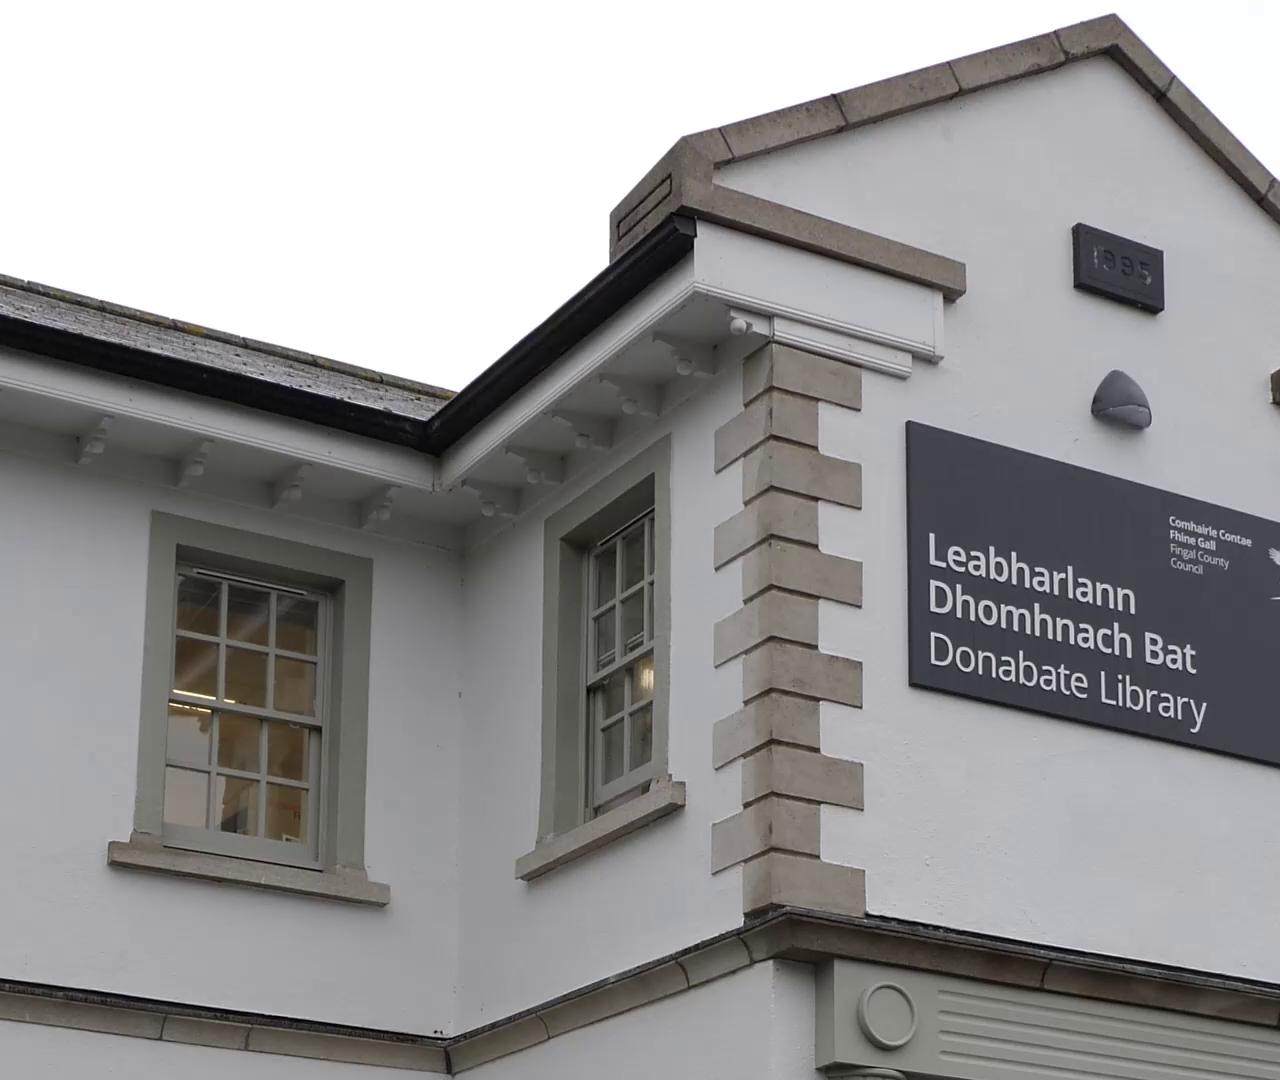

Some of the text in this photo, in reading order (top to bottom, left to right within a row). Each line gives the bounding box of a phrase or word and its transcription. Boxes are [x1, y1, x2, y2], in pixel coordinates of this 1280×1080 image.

[1169, 516, 1253, 547] Comhairle Contae
[1170, 530, 1217, 551] Fhine Gall
[1170, 543, 1230, 570] Fingal County
[1170, 557, 1204, 575] Council
[928, 532, 1136, 614] Leabharlann
[929, 578, 1198, 674] Dhomhnach Bat
[929, 631, 1208, 733] Donabate Library
